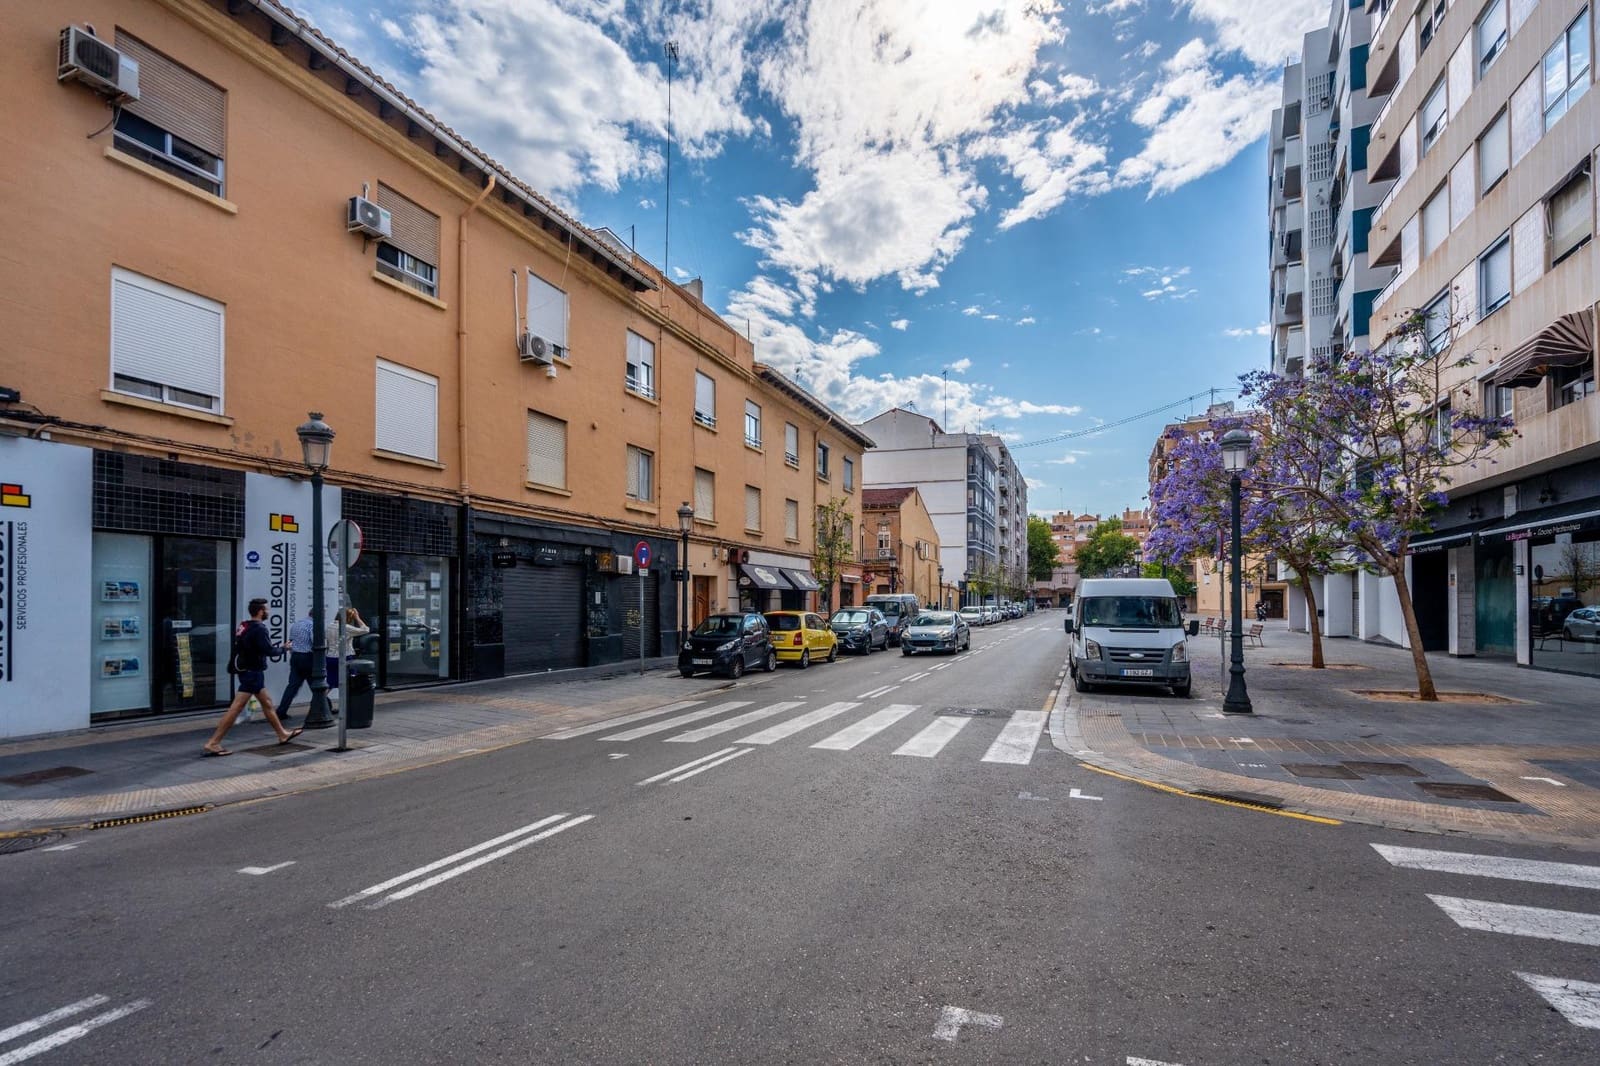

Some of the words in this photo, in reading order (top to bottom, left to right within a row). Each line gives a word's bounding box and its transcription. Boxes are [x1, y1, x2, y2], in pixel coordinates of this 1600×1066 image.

[16, 521, 28, 586] PROFESIONALES
[270, 542, 284, 608] BOLUDA
[289, 542, 297, 592] PROFESIONALES
[16, 588, 27, 630] SERVICIOS
[289, 592, 297, 624] SERVICIOS
[270, 614, 283, 663] CANO
